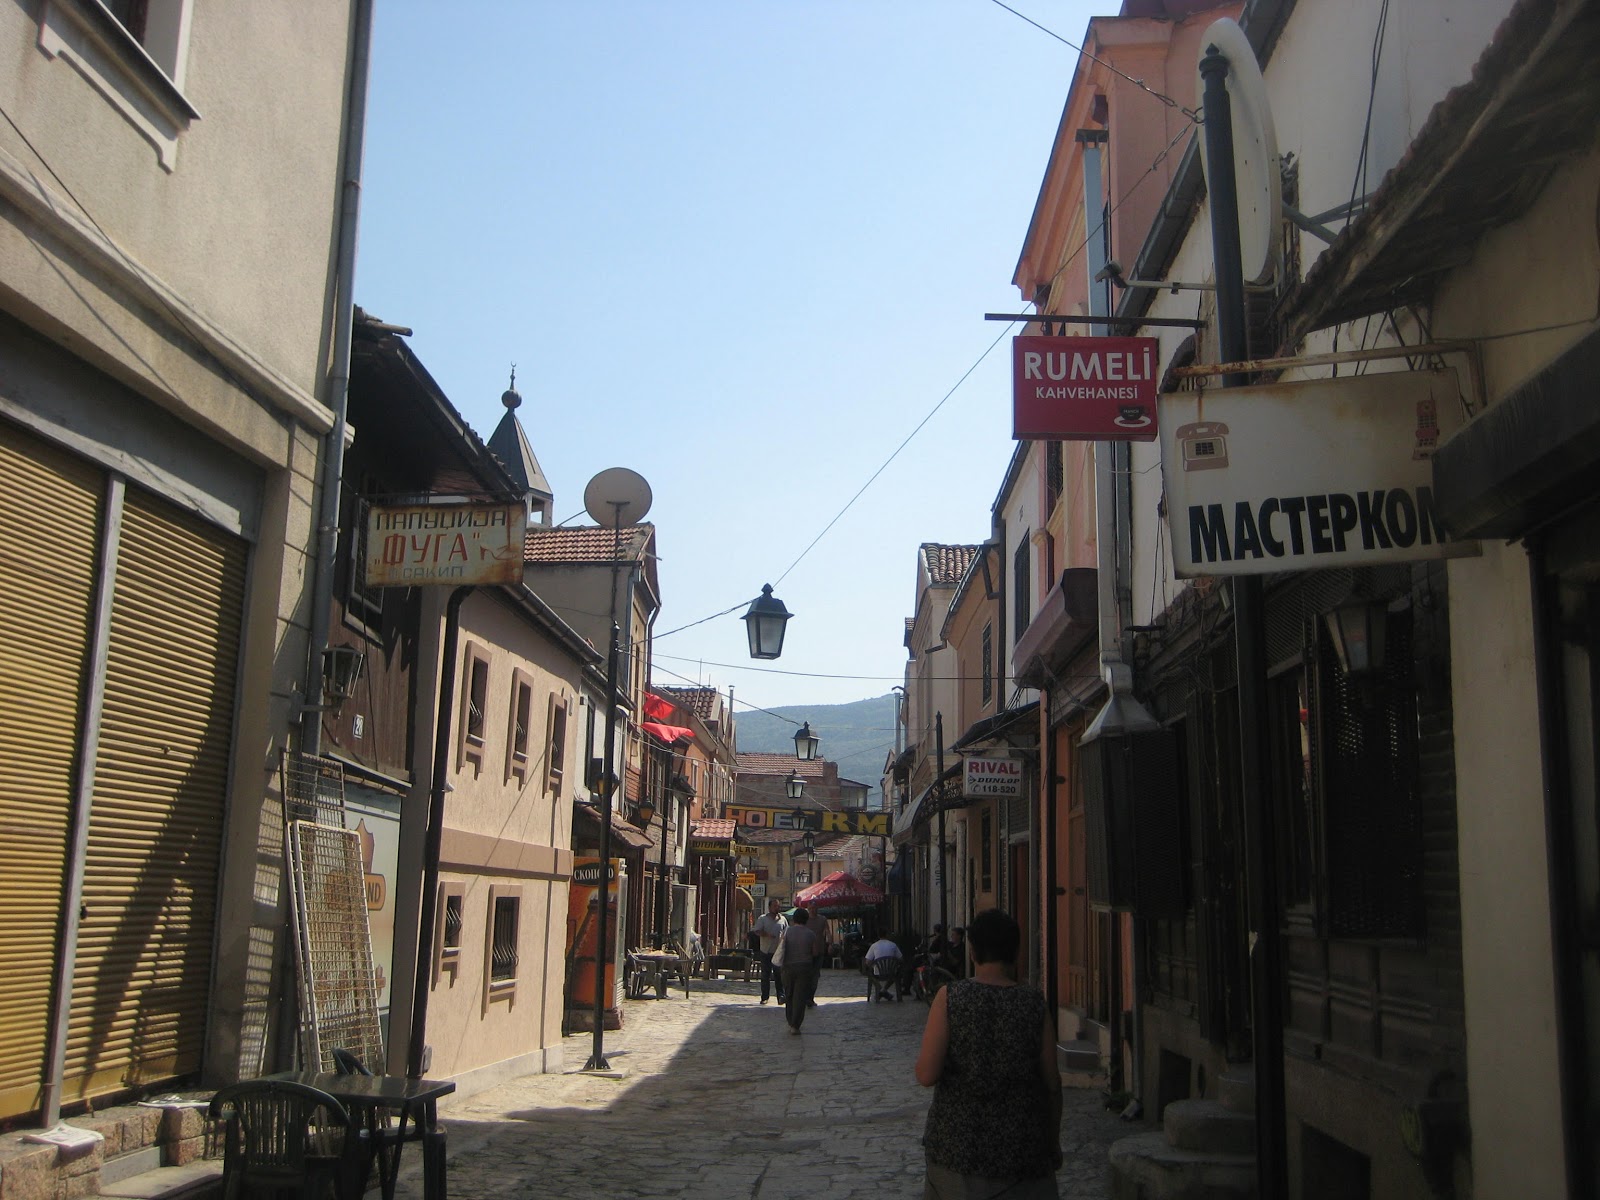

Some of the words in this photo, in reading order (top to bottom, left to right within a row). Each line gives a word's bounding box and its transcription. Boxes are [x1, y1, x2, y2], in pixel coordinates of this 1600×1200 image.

[1024, 347, 1151, 381] RUMELİ
[1036, 385, 1138, 399] KAHVEHANESİ
[968, 761, 1020, 774] RIVAL
[982, 785, 1016, 793] 118-520
